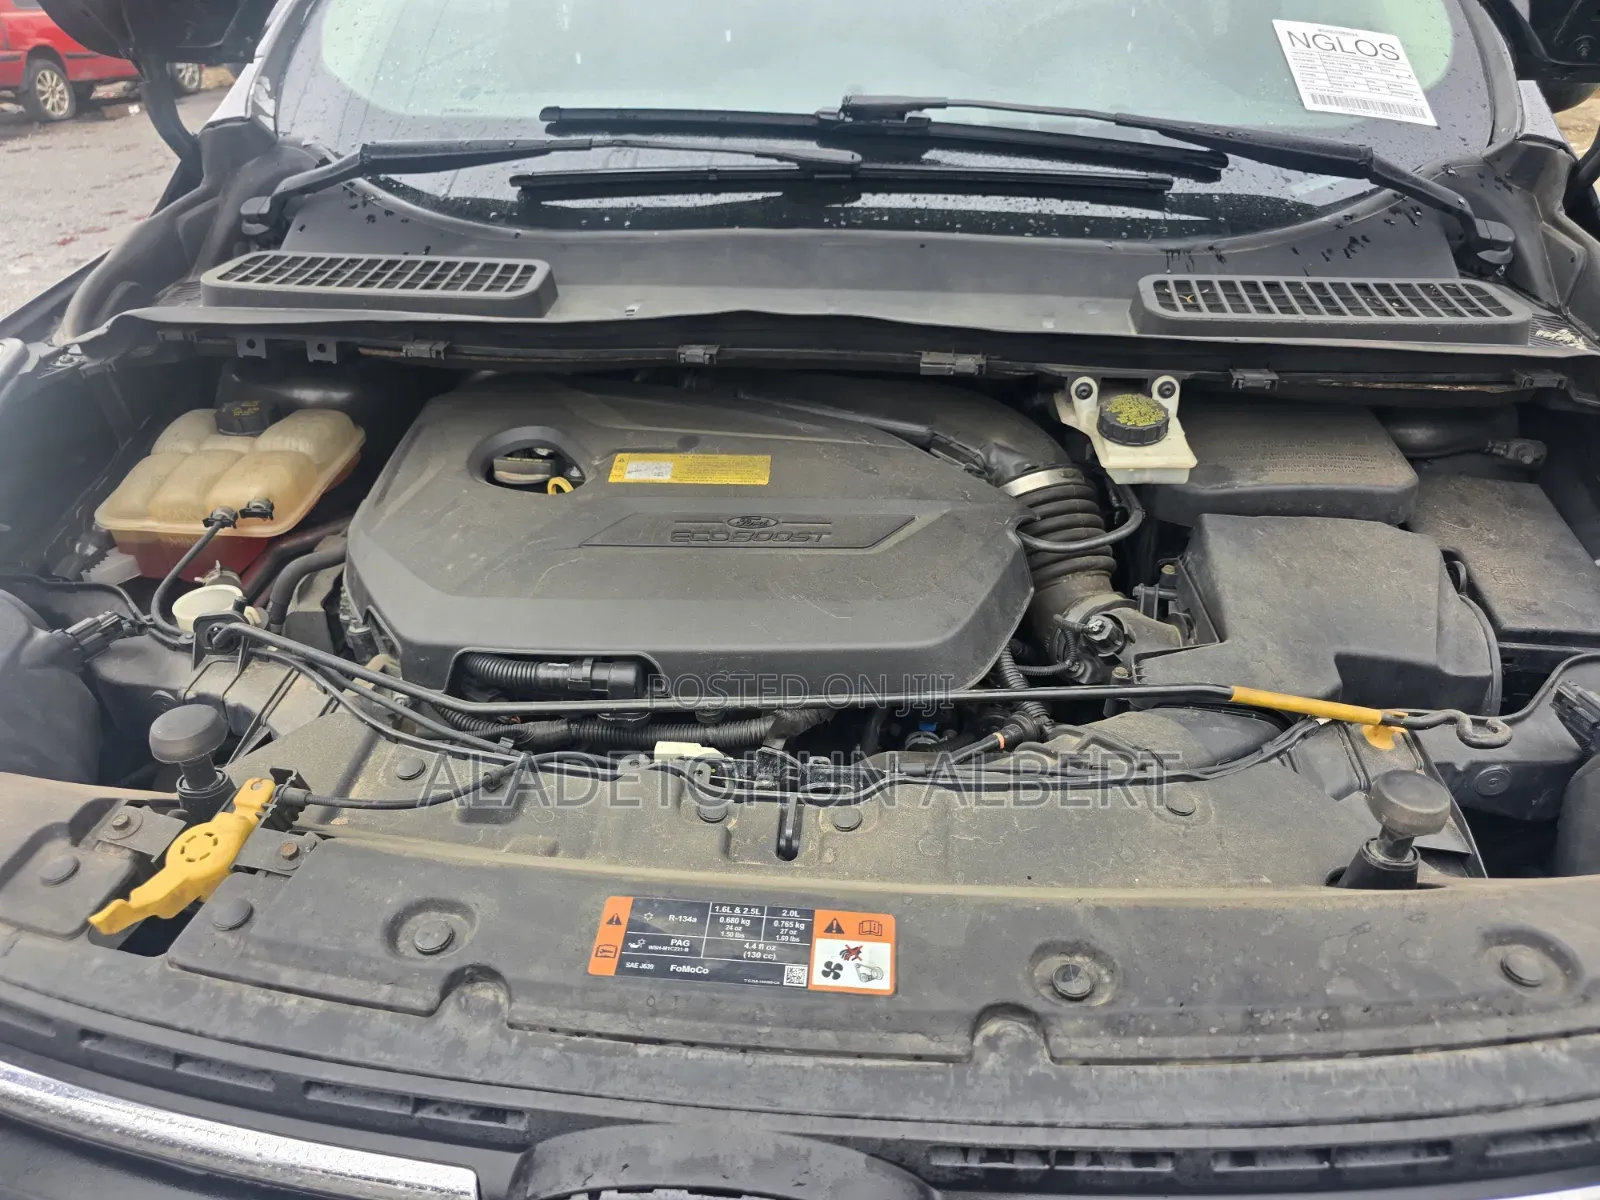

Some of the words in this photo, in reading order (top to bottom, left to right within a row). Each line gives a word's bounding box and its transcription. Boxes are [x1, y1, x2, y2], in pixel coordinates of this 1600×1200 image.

[1286, 30, 1400, 61] NGLOS
[736, 516, 770, 527] Ford
[670, 530, 832, 543] ECOBOOST
[714, 905, 733, 914] 1.6L
[742, 907, 761, 915] 2.5L
[781, 909, 800, 917] 2.0L
[668, 914, 698, 923] R-134a
[719, 916, 740, 924] 0.680
[741, 917, 751, 927] kg
[773, 920, 794, 928] 0.765
[795, 921, 805, 930] kg
[670, 938, 691, 947] PAG
[743, 950, 761, 959] (130
[625, 961, 639, 969] SAE
[669, 964, 709, 974] FoMoCo
